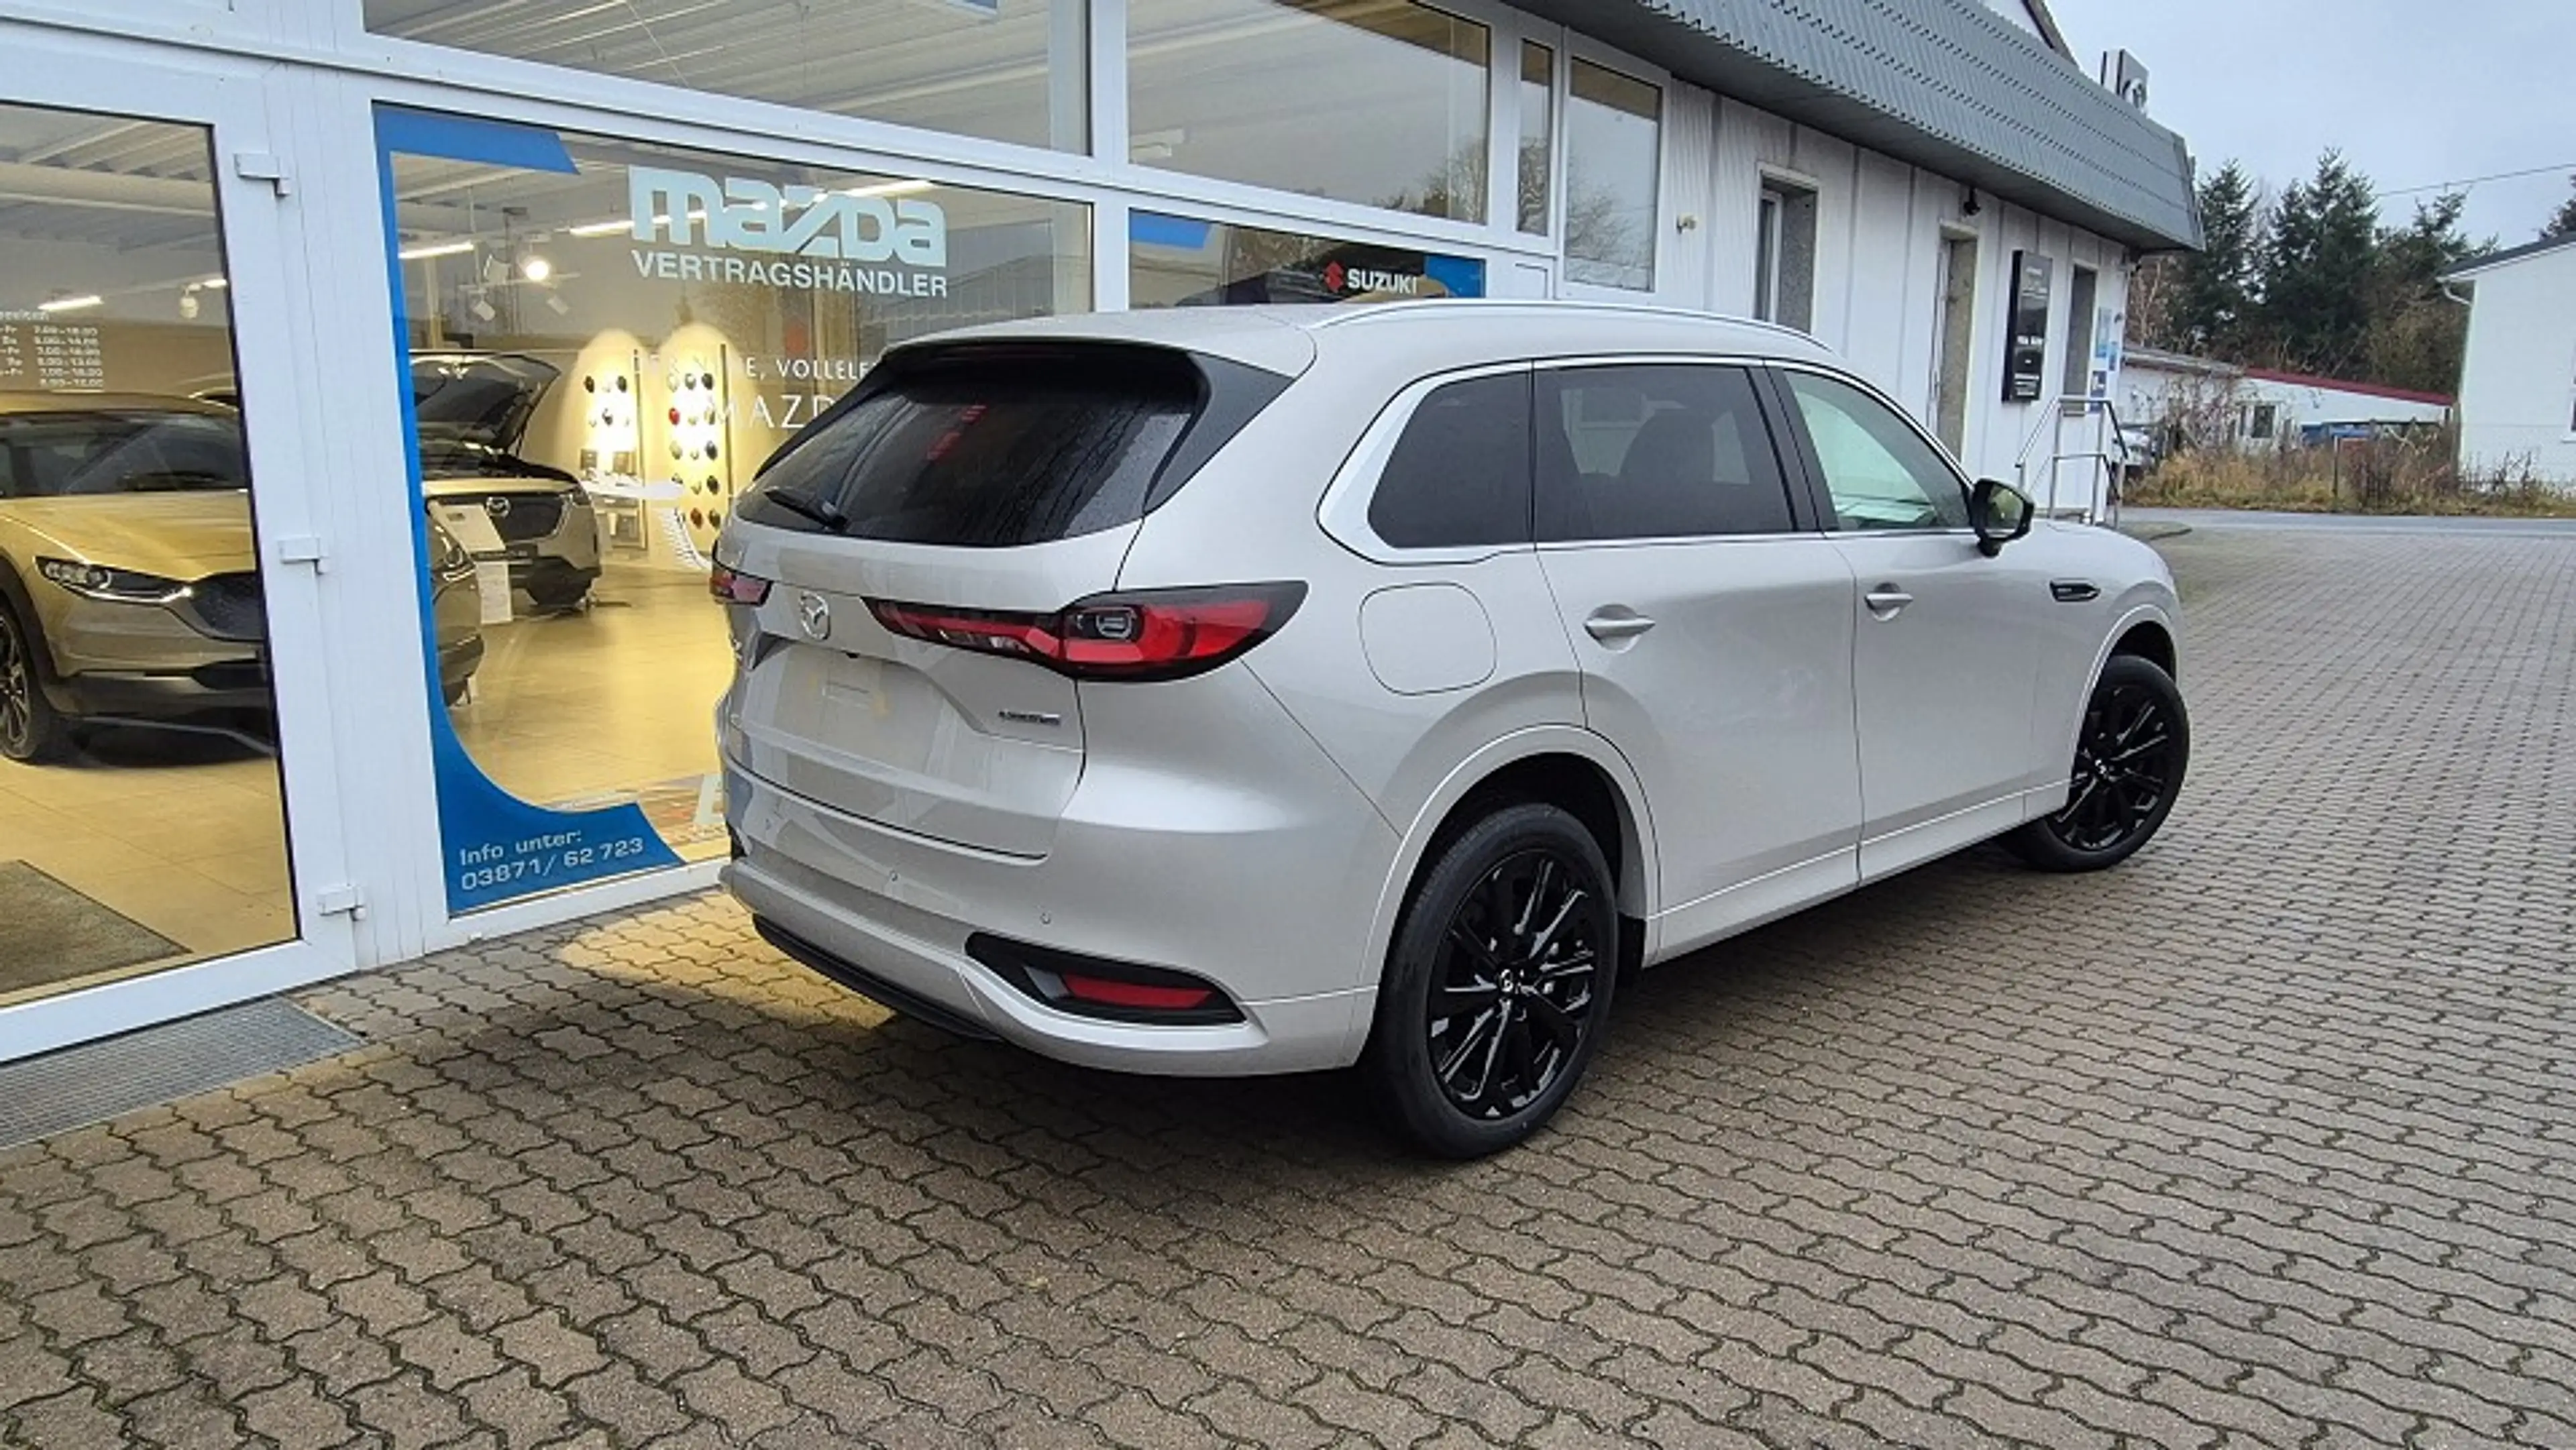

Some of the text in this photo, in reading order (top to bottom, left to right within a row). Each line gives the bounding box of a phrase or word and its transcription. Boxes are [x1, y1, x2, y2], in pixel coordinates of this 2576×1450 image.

[631, 249, 947, 298] VERTRAGSHÄNDLER
[1348, 268, 1417, 295] SUZUKI
[459, 830, 582, 866] Info unter:
[564, 848, 594, 867] 62
[599, 837, 643, 860] 723
